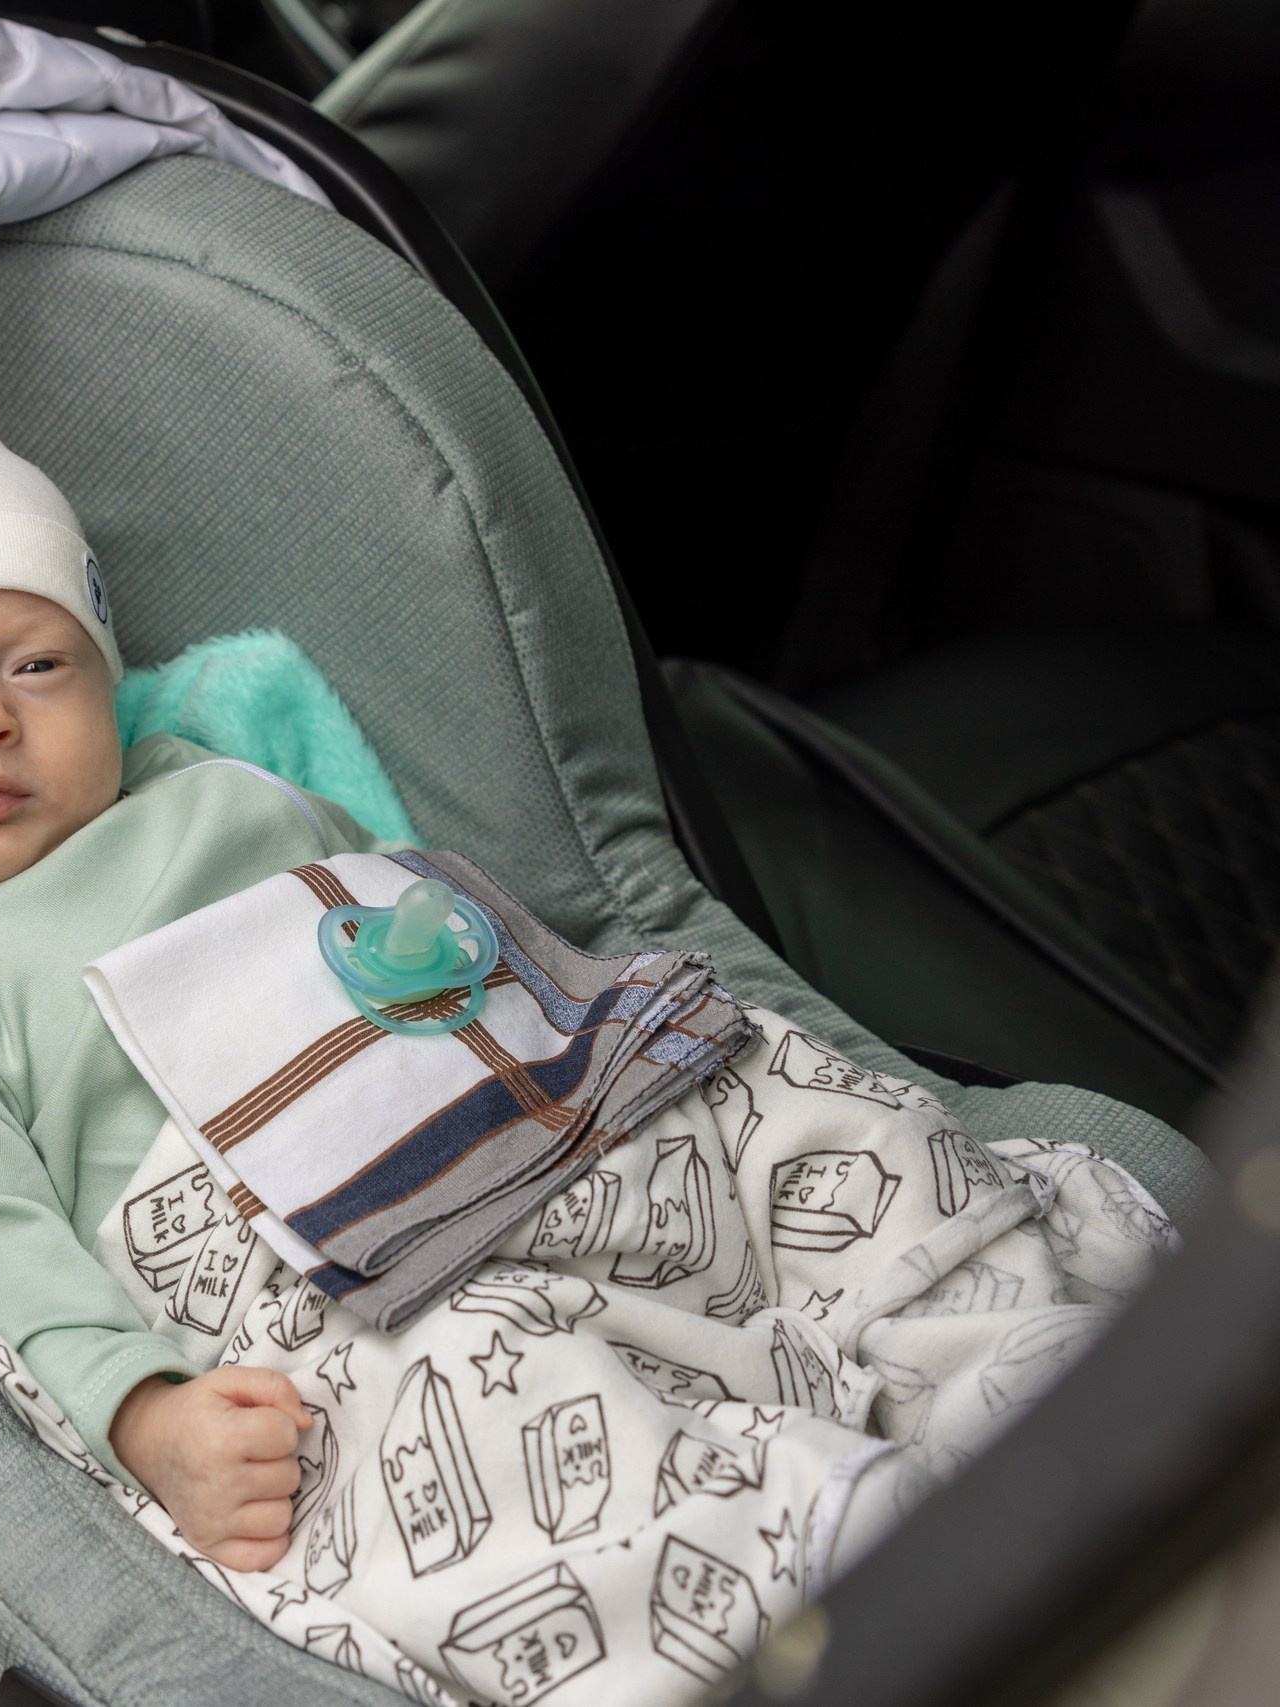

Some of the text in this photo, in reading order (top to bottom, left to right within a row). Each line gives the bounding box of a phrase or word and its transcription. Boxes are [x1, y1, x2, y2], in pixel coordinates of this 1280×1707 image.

[778, 1162, 808, 1200] MILK
[150, 1196, 170, 1244] MILK
[193, 1276, 230, 1298] MILK
[562, 1437, 602, 1466] MILK
[410, 1508, 448, 1544] MILK
[519, 1629, 552, 1687] MILK
